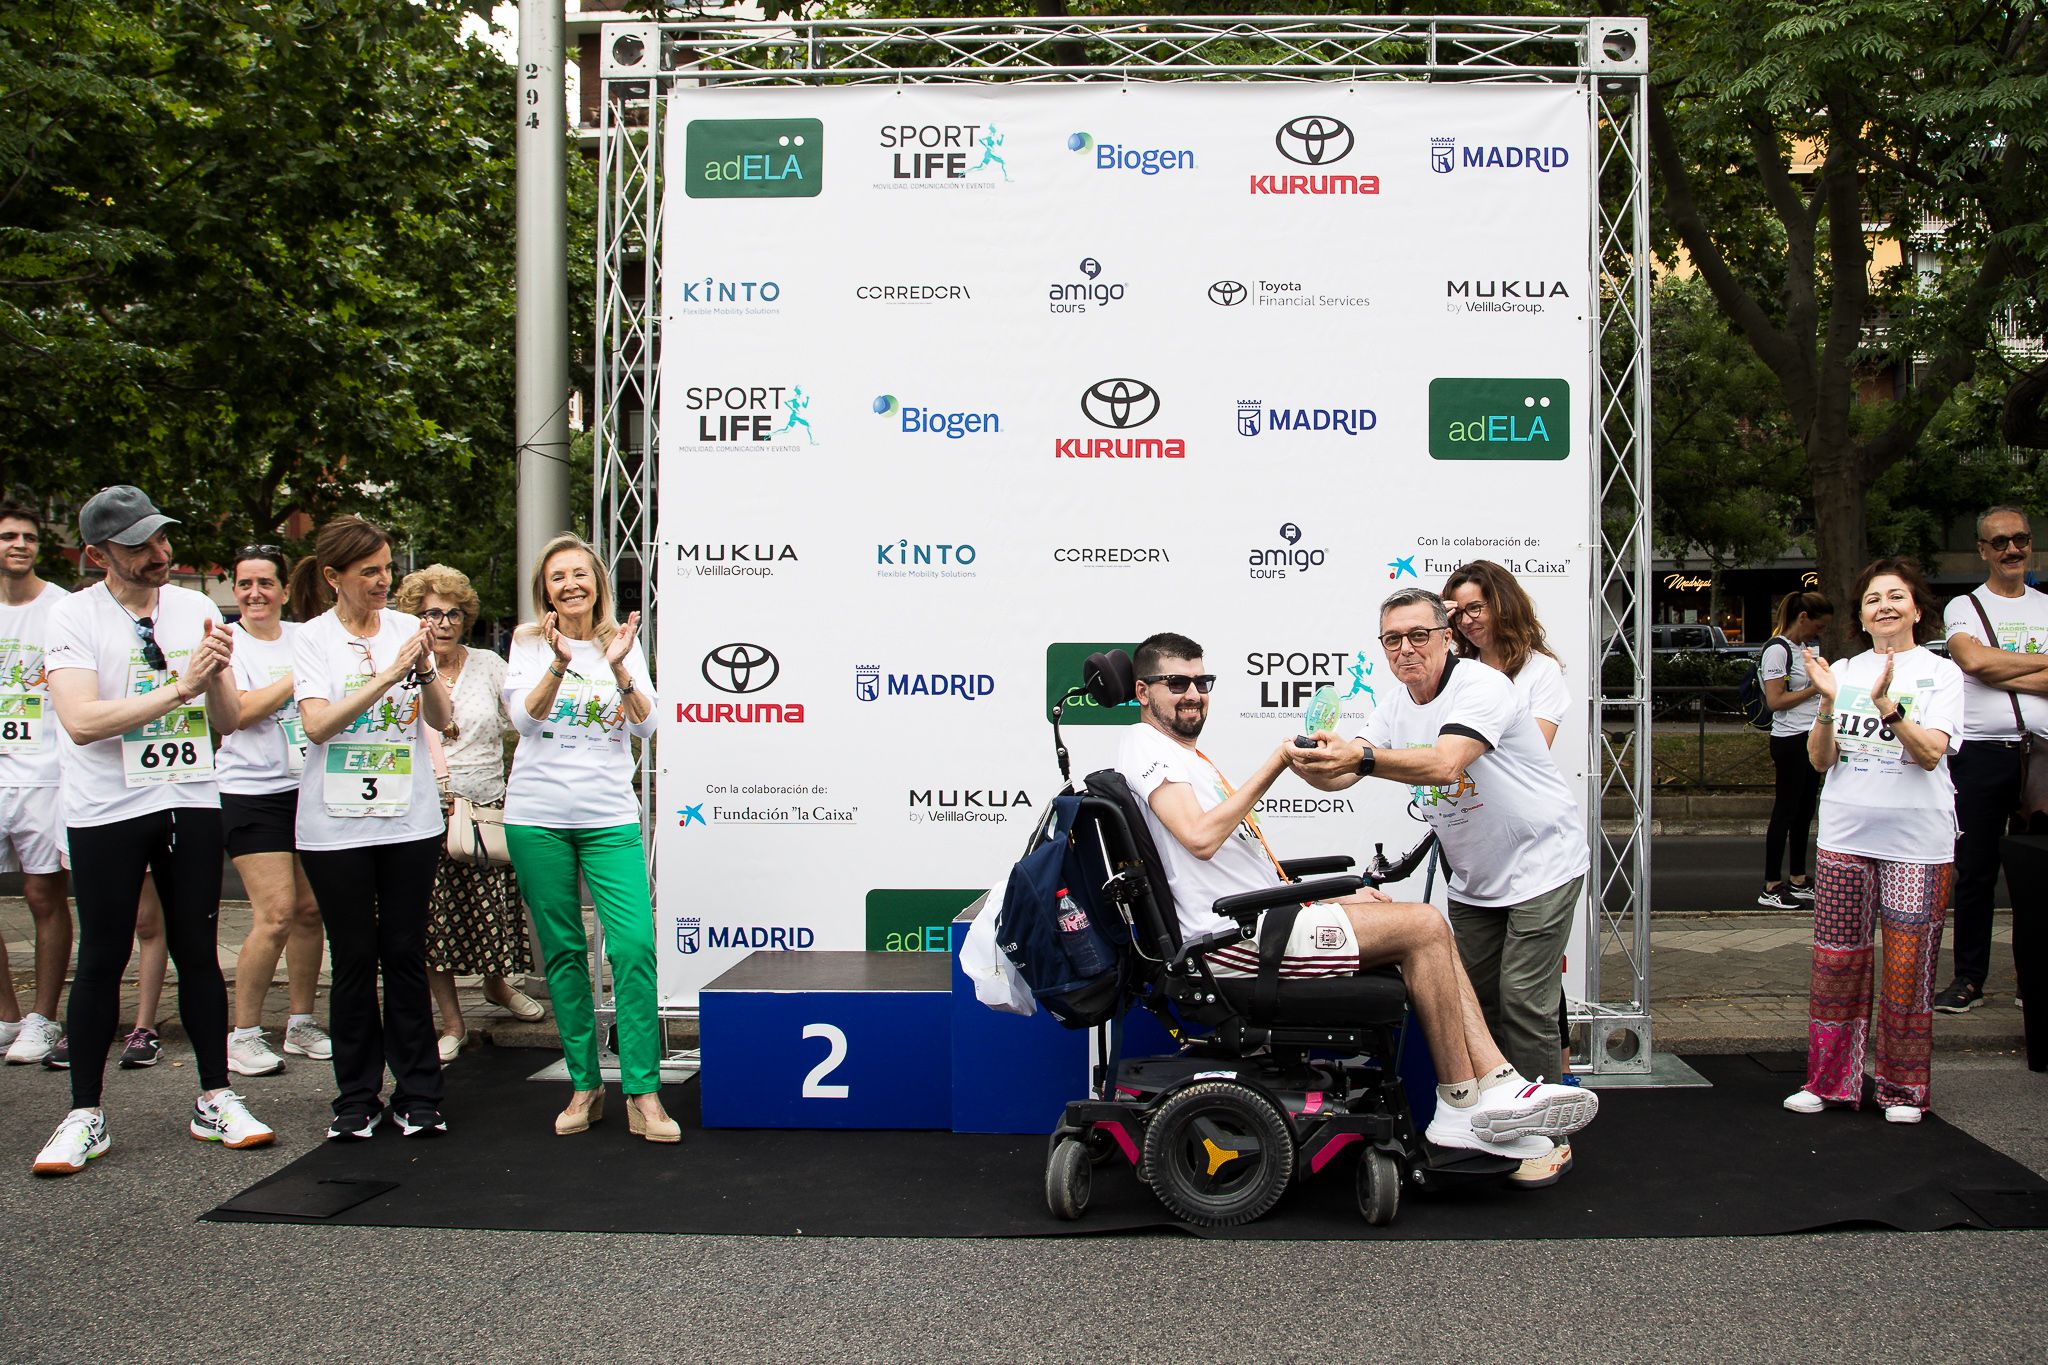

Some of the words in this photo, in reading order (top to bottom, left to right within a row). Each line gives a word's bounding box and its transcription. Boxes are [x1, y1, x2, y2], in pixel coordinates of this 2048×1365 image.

[880, 126, 980, 147] SPORT
[704, 154, 803, 181] adELA
[894, 153, 966, 178] LIFE
[1097, 144, 1194, 175] Biogen
[1464, 147, 1569, 172] MADRID
[1259, 281, 1301, 293] Toyota
[1448, 281, 1569, 297] MUKUA
[1051, 302, 1085, 313] tours
[1260, 296, 1315, 306] Financial
[1320, 296, 1369, 306] Services
[1447, 302, 1462, 315] by
[1466, 302, 1544, 316] VelillaGroup.
[686, 387, 786, 410] SPORT
[699, 416, 772, 441] LIFE
[902, 407, 999, 438] Biogen
[1270, 409, 1376, 435] MADRID
[1448, 416, 1549, 442] adELA
[678, 545, 798, 561] MUKUA
[1417, 536, 1437, 547] Con
[1441, 536, 1450, 547] la
[1453, 536, 1520, 548] colaboración
[1524, 536, 1540, 547] de:
[678, 566, 692, 577] by
[696, 565, 773, 578] VelillaGroup.
[1250, 567, 1286, 579] tours
[1247, 653, 1349, 676] SPORT
[888, 674, 994, 700] MADRID
[141, 741, 197, 769] 698
[344, 751, 395, 771] ELA
[361, 777, 378, 801] 3
[706, 785, 726, 794] Con
[730, 785, 738, 794] la
[742, 784, 807, 795] colaboración
[810, 785, 828, 794] de:
[910, 790, 1031, 807] MUKUA
[713, 806, 789, 821] Fundación
[910, 811, 924, 824] by
[928, 810, 1007, 824] VelillaGroup.
[709, 928, 814, 951] MADRID
[801, 1023, 850, 1098] 2
